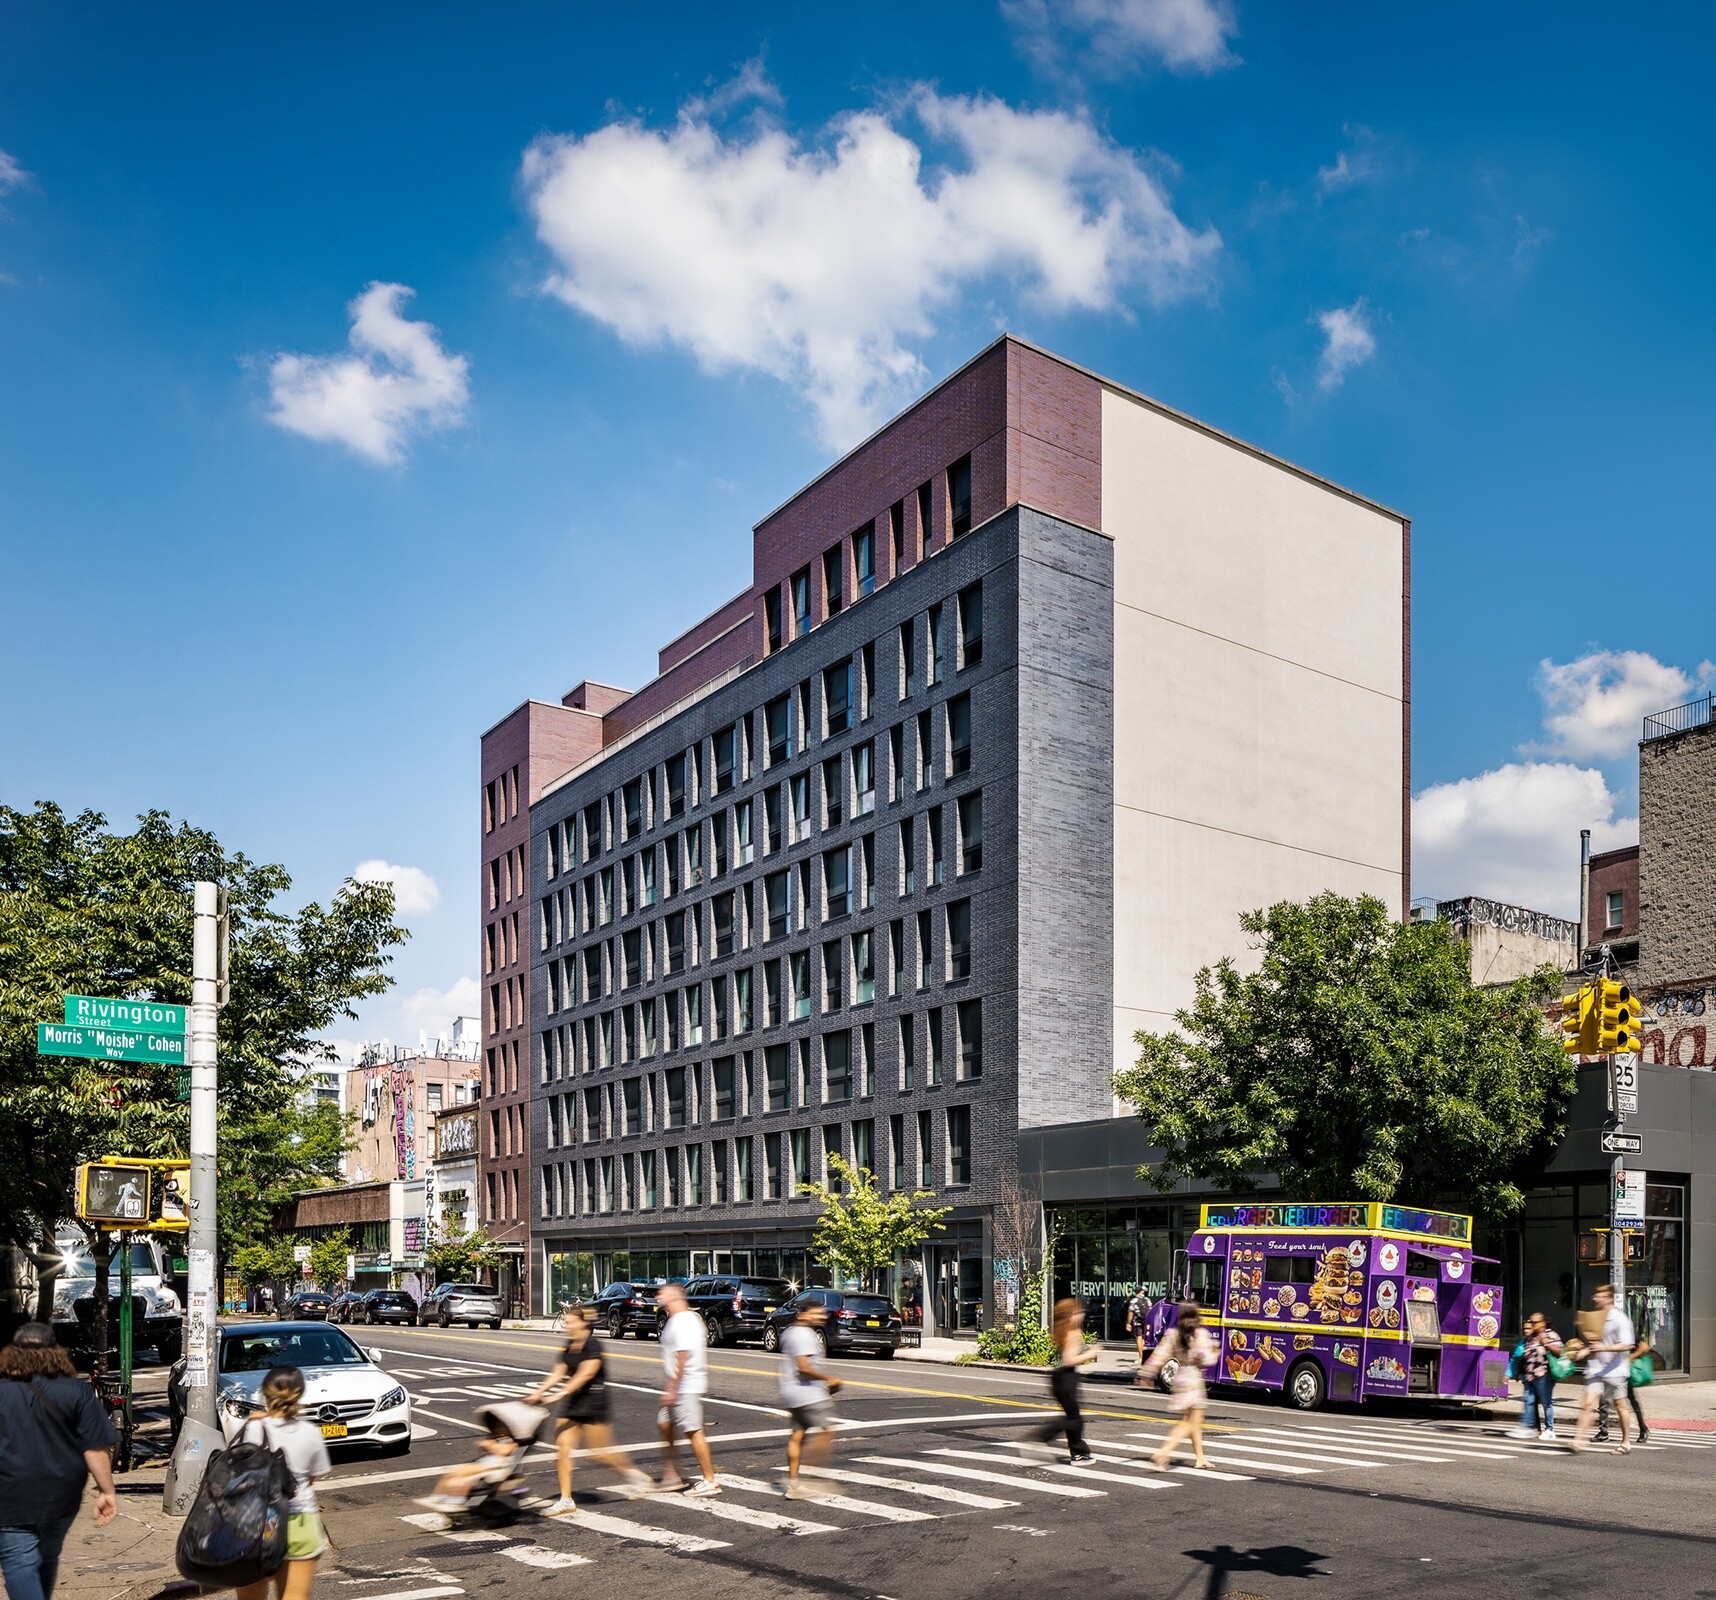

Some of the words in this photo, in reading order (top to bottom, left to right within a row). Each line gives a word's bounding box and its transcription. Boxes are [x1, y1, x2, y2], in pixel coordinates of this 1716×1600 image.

[78, 1000, 176, 1024] Rivington
[79, 1016, 111, 1027] Street
[45, 1026, 82, 1044] Morris
[87, 1030, 143, 1048] "Moishe"
[148, 1035, 182, 1053] Cohen
[106, 1048, 124, 1058] Way
[1615, 1064, 1634, 1087] 25
[1608, 1138, 1620, 1147] ONE
[1625, 1140, 1639, 1148] WAY
[1618, 1190, 1624, 1198] 2
[1268, 1240, 1288, 1250] Feed
[1289, 1243, 1307, 1252] your
